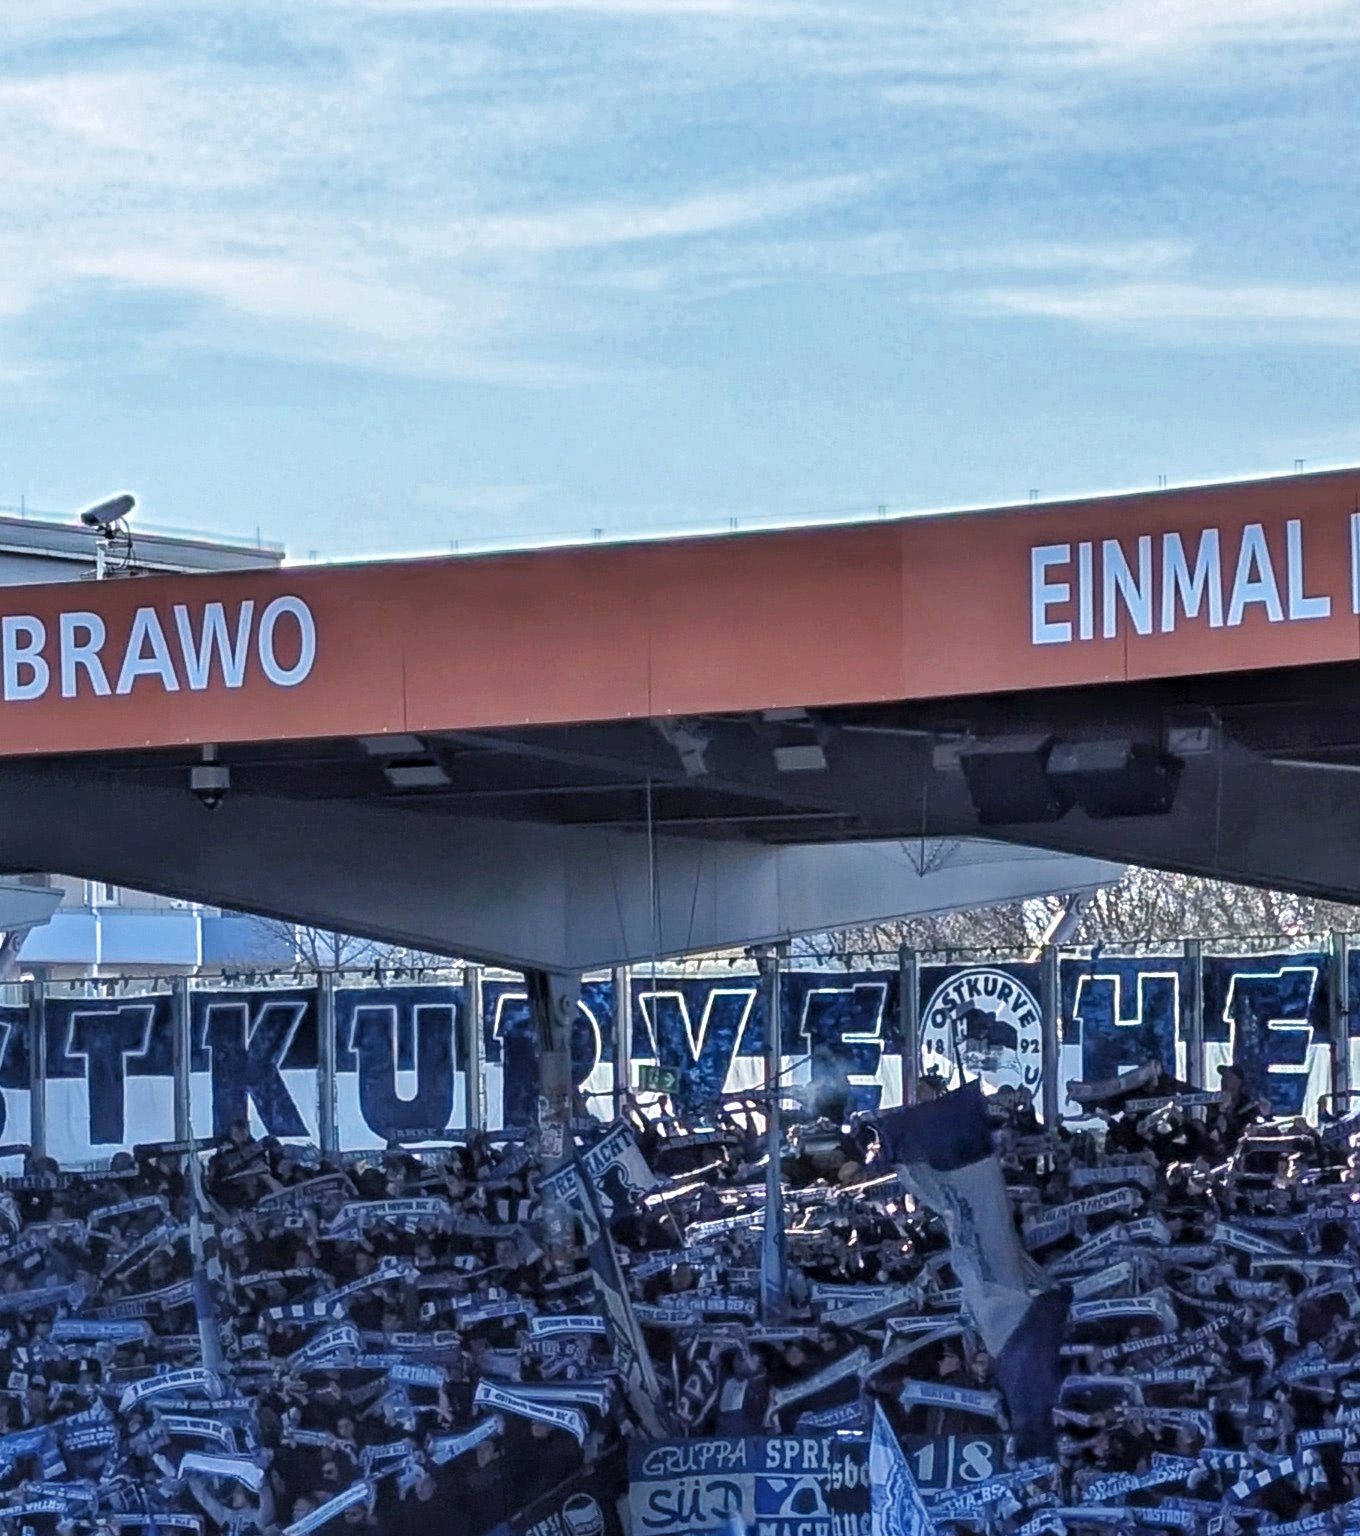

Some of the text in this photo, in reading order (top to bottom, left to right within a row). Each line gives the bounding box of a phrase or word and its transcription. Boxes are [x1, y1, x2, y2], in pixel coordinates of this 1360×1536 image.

[1030, 517, 1329, 644] EINMAL
[1, 595, 317, 703] BRAWO
[931, 976, 1037, 1029] OSTKURVE
[767, 1439, 830, 1470] SPRE
